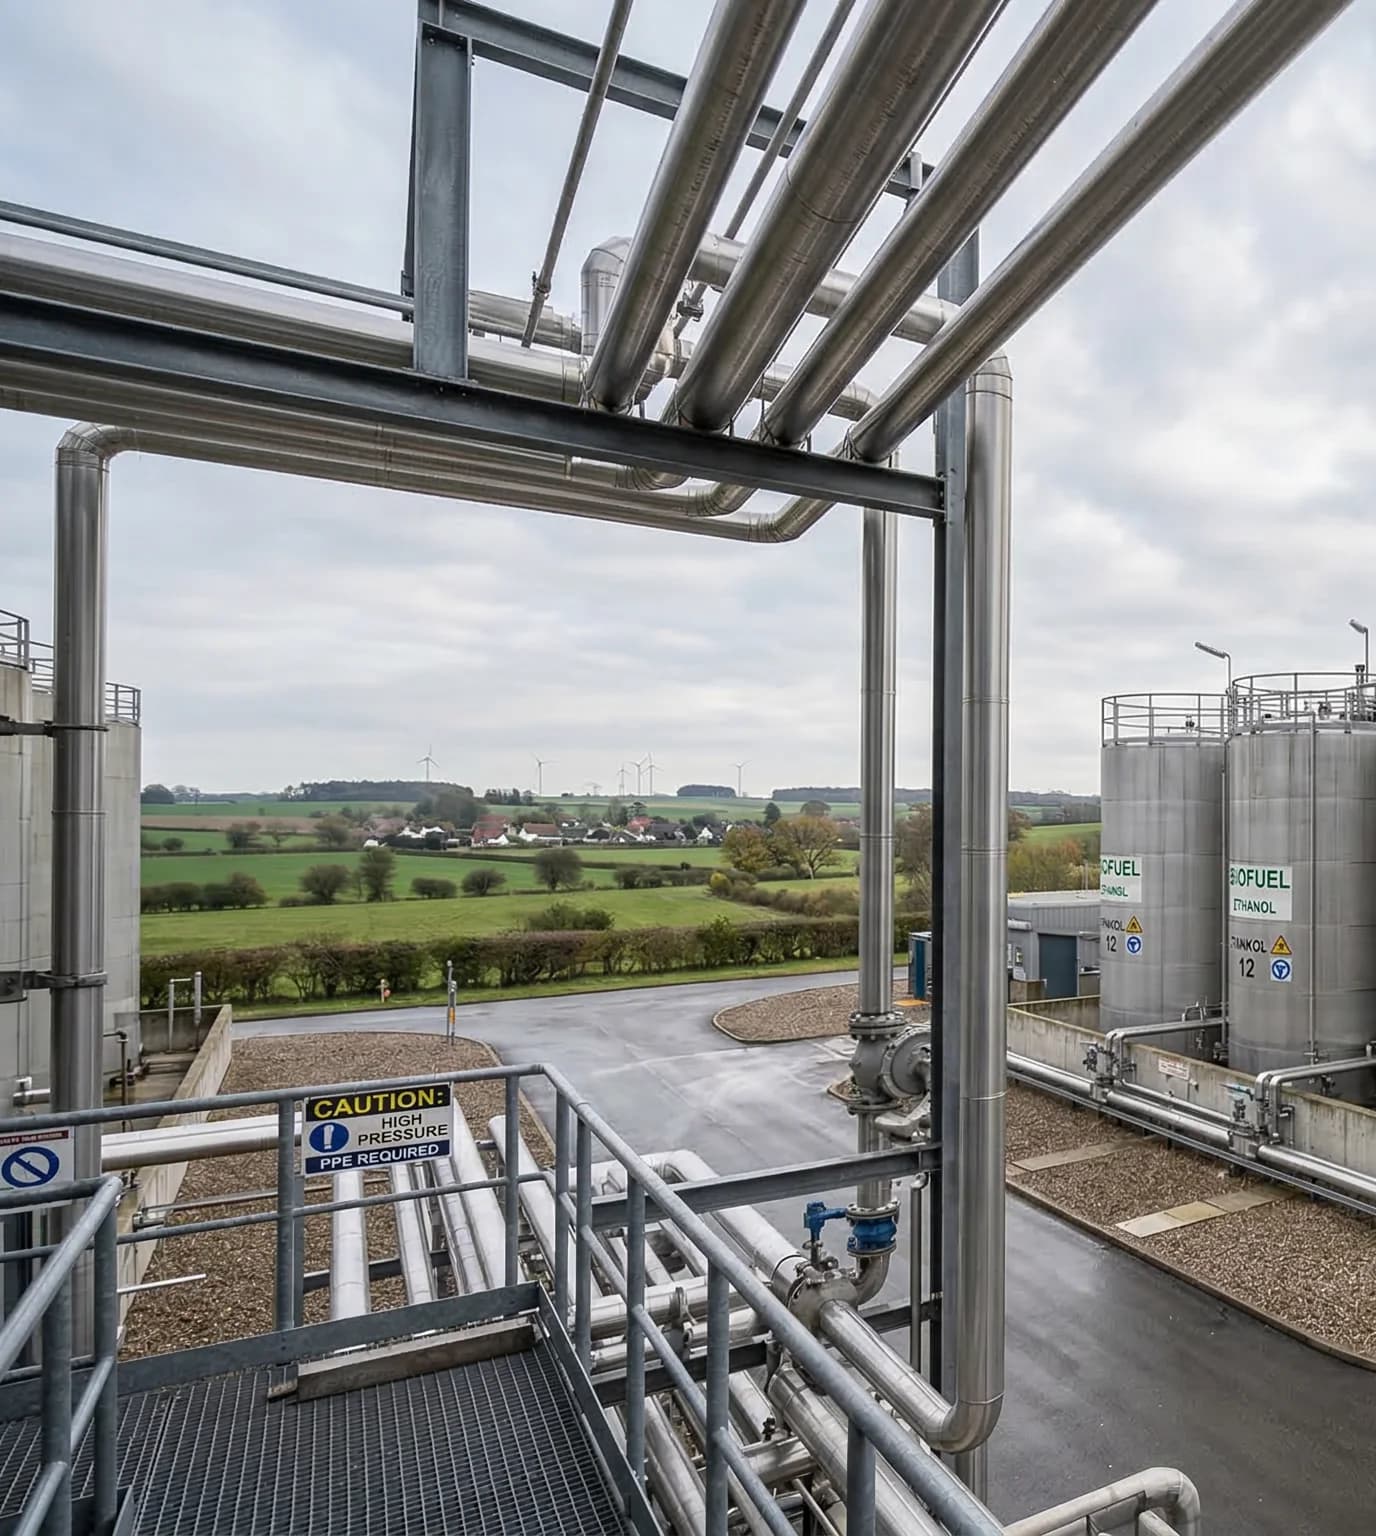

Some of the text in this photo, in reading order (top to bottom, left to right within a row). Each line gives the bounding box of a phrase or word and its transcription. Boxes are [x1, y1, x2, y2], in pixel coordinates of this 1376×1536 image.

[1106, 935, 1117, 952] 12
[1239, 957, 1255, 978] 12
[313, 1088, 444, 1119] CAUTION:
[381, 1113, 422, 1130] HIGH
[358, 1124, 449, 1146] PRESSURE
[320, 1144, 439, 1170] PPE REQUIRED
